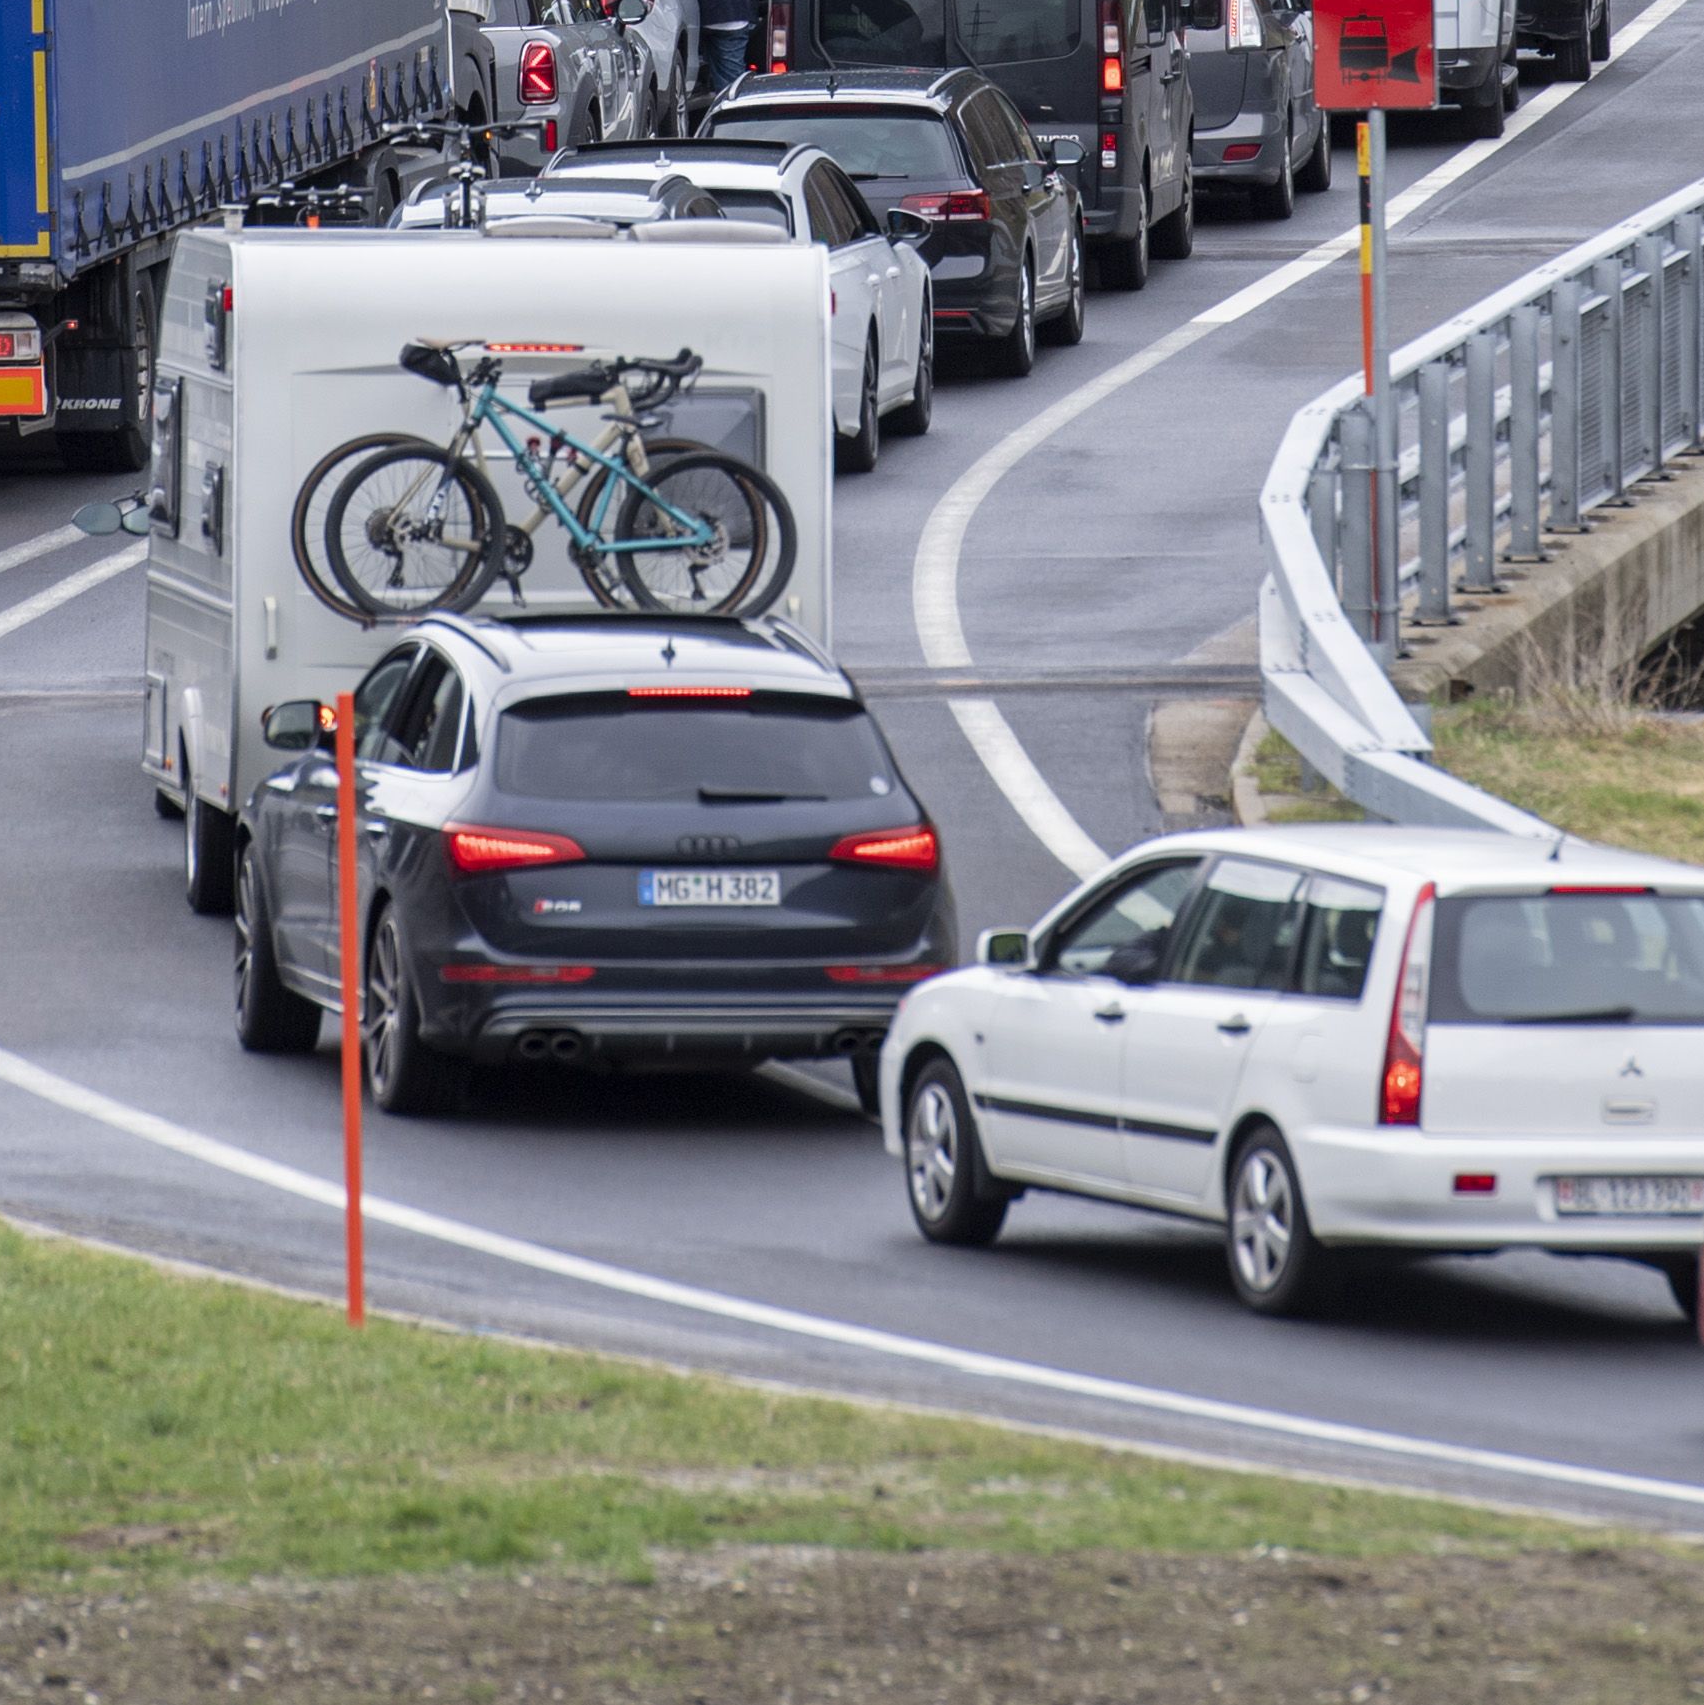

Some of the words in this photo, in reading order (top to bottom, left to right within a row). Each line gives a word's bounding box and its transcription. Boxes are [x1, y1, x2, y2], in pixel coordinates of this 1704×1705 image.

[61, 398, 122, 410] KRONE
[657, 878, 689, 900] MG
[706, 878, 722, 900] H
[729, 878, 773, 900] 382
